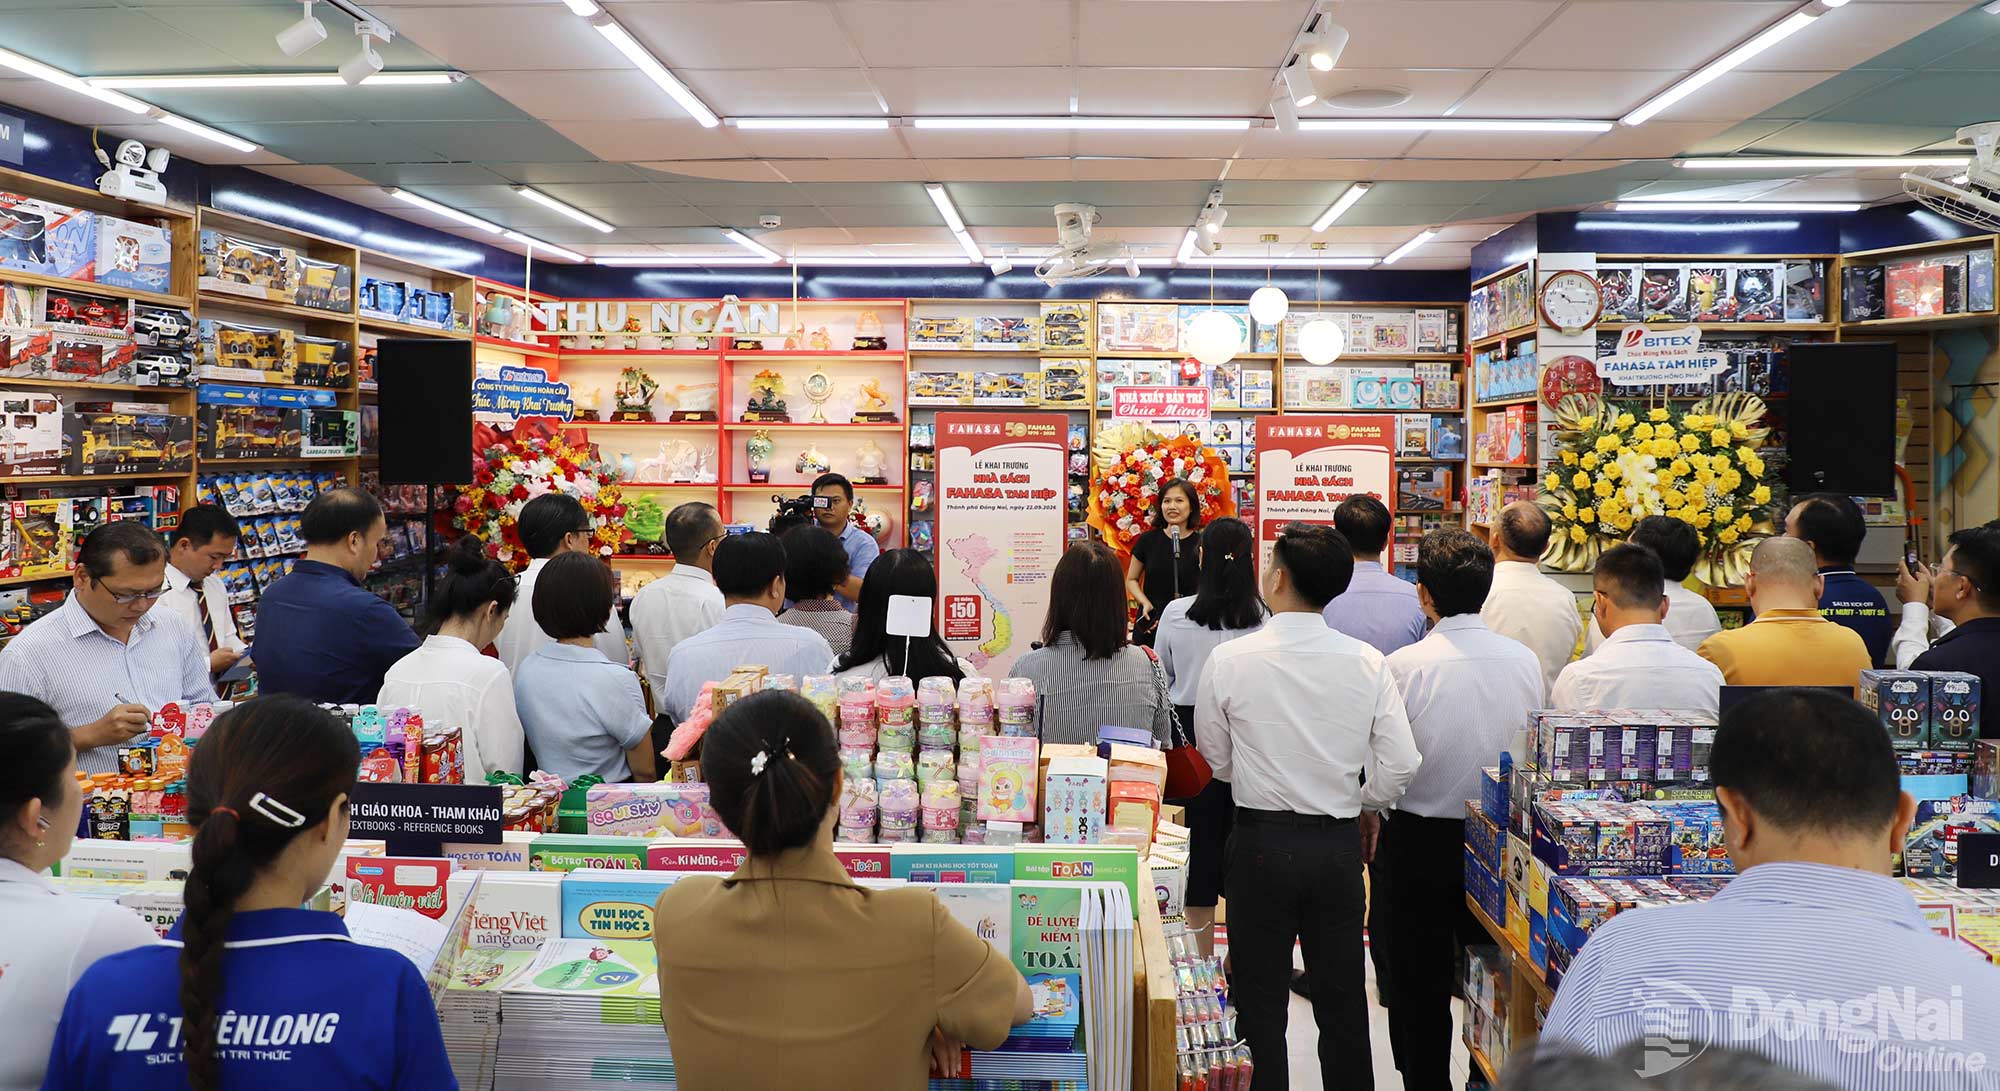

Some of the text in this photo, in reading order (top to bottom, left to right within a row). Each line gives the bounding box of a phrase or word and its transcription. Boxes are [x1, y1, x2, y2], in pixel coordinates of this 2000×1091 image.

[539, 294, 780, 334] THU NGÂN
[1644, 336, 1692, 347] BITEX
[1604, 356, 1718, 372] FAHASA TAM HIỆP
[477, 382, 494, 391] CÔNG
[503, 384, 520, 392] THIÊN
[521, 386, 537, 394] LONG
[537, 385, 554, 395] HOÀN
[555, 387, 567, 395] CẦU
[1119, 389, 1204, 404] NHÀ XUẤT BẢN TRẺ
[491, 394, 520, 415] Mừng
[522, 396, 542, 411] Khai
[1119, 403, 1206, 418] Chúc Mừng
[948, 423, 1001, 434] FAHASA
[1268, 426, 1322, 437] FAHASA
[975, 459, 1029, 470] LỄ KHAI TRƯƠNG
[1296, 462, 1352, 473] LỄ KHAI TRƯƠNG
[973, 472, 1030, 484] NHÀ SÁCH
[1294, 475, 1354, 487] NHÀ SÁCH
[946, 487, 1057, 501] FAHASA TAM HIỆP
[1266, 490, 1325, 502] FAHASA
[950, 602, 976, 618] 150
[361, 801, 388, 817] GIÁO
[390, 804, 423, 818] KHOA
[431, 806, 466, 820] THAM
[468, 804, 500, 821] KHẢO
[592, 801, 661, 826] SQUISHY
[403, 822, 452, 834] REFERENCE
[455, 823, 484, 835] BOOKS
[447, 850, 522, 863] HỌC TỐT TOÁN
[551, 854, 564, 865] BỔ
[584, 854, 626, 870] TOÁN
[631, 859, 641, 870] 3
[661, 856, 677, 866] Rèn
[953, 862, 965, 870] HỌC
[967, 861, 979, 869] TỐT
[980, 861, 998, 869] TOÁN
[1053, 862, 1093, 877] TOÁN
[418, 886, 444, 908] viết
[593, 908, 644, 921] VUI HỌC
[1027, 913, 1043, 926] ĐỀ
[470, 911, 547, 935] iếng Việt
[590, 919, 650, 932] TIN HỌC 2
[477, 932, 511, 948] nâng
[512, 934, 536, 944] cao
[1041, 927, 1071, 942] KIỂM
[1023, 946, 1081, 968] TOÁ
[167, 1010, 340, 1048] TÊNLONG
[146, 1053, 176, 1065] SỨC
[229, 1050, 250, 1060] TRI
[255, 1049, 291, 1061] THỨC
